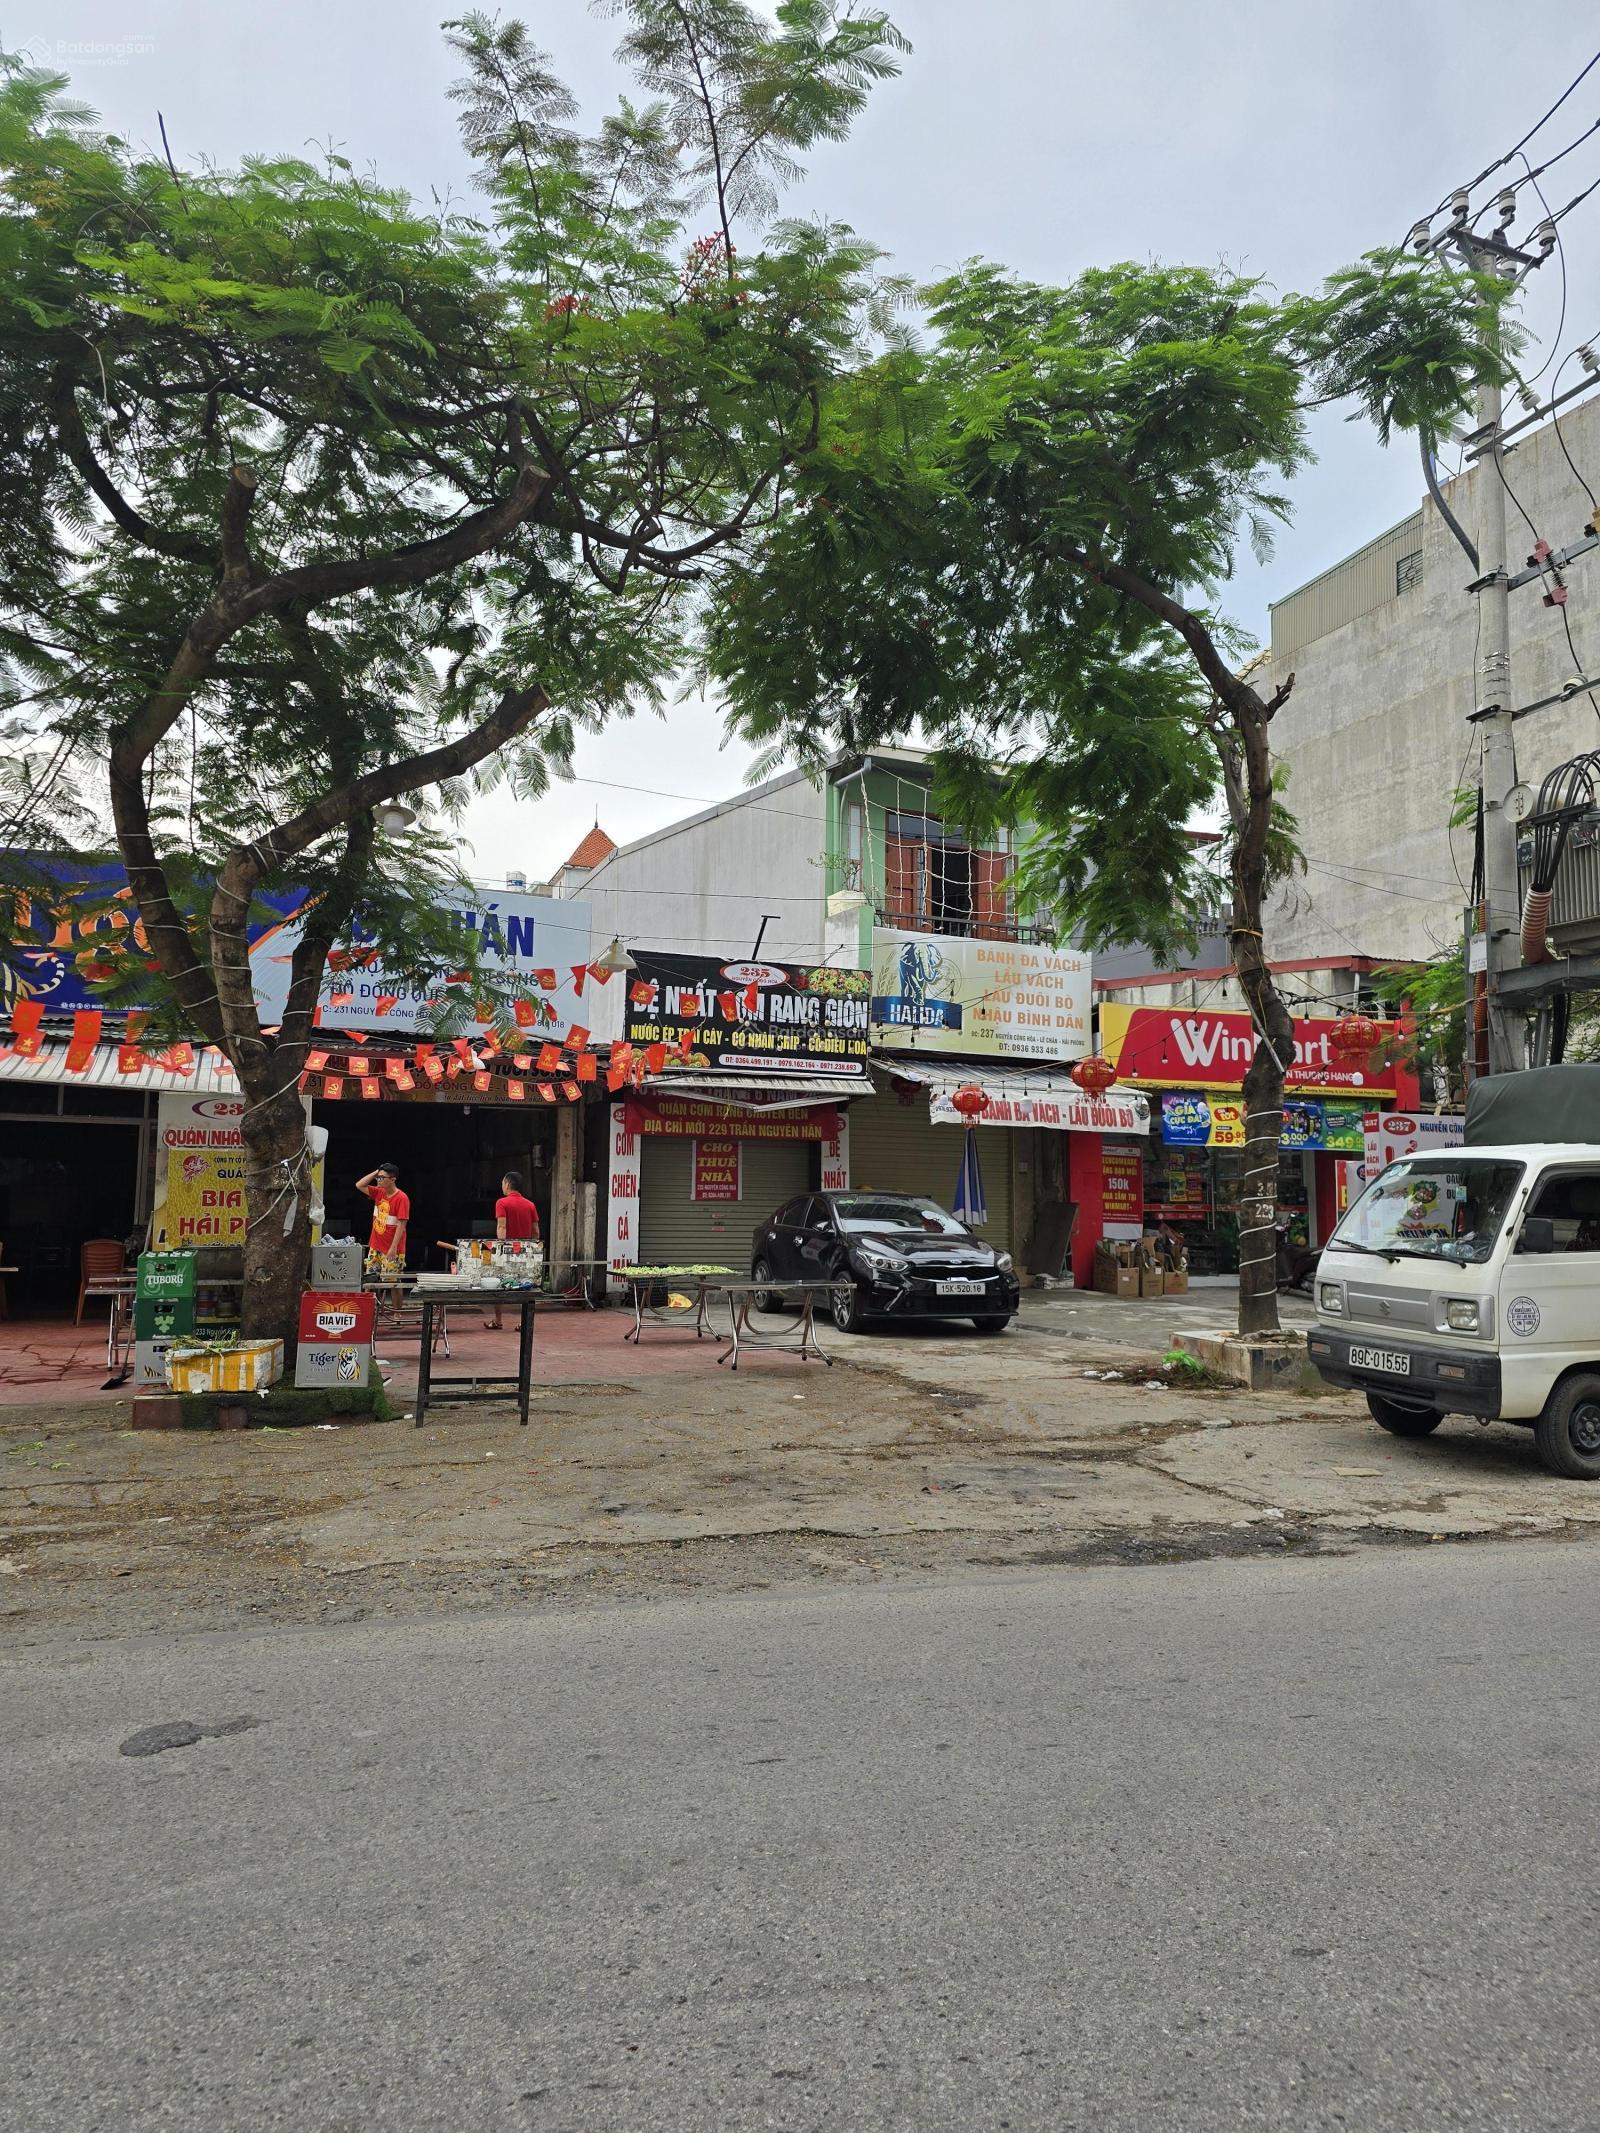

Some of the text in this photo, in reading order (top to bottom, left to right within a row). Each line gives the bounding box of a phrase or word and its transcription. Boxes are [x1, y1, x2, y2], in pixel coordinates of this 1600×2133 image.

[976, 946, 1015, 966] BÁNH
[1020, 954, 1039, 968] ĐA
[740, 966, 771, 977] 235
[1016, 990, 1049, 1007] ĐUÔI
[1055, 993, 1073, 1010] BÒ
[334, 1005, 348, 1014] 231
[350, 1006, 388, 1017] NGUY
[390, 1007, 414, 1018] CÔNG
[770, 995, 821, 1024] RANG
[825, 994, 868, 1029] GIÒN
[890, 1004, 944, 1027] HALIDA
[973, 1006, 1084, 1030] NHẬU BÌNH DÂN
[631, 1022, 660, 1041] NƯỚC
[662, 1023, 675, 1042] ÉP
[703, 1027, 723, 1046] CÂY
[980, 1028, 994, 1038] 237
[999, 1043, 1010, 1052] ĐT:
[1012, 1044, 1029, 1053] 0936
[1031, 1045, 1044, 1054] 933
[1170, 1018, 1332, 1067] Winart
[213, 1102, 245, 1116] 23
[1032, 1099, 1060, 1124] VÁCH
[1120, 1103, 1134, 1128] BÒ
[644, 1120, 662, 1135] ĐỊA
[709, 1124, 727, 1136] 229
[1387, 1120, 1465, 1133] 237 NGUYỄN CÔN
[164, 1127, 207, 1147] QUÁN
[702, 1142, 733, 1153] CHO
[697, 1155, 737, 1168] THUÊ
[217, 1166, 247, 1179] QUÁ
[701, 1169, 733, 1182] NHÀ
[824, 1164, 847, 1189] NHẤT
[611, 1169, 637, 1198] CHIÊN
[1108, 1178, 1130, 1190] 150k
[202, 1190, 241, 1207] BIA
[179, 1212, 220, 1237] HẢI
[617, 1211, 629, 1240] CÁ
[146, 1274, 184, 1285] TUBORG
[941, 1284, 982, 1294] 15K-520.18
[319, 1314, 354, 1328] BIA VIỆT
[1351, 1348, 1408, 1372] 89C-015.55
